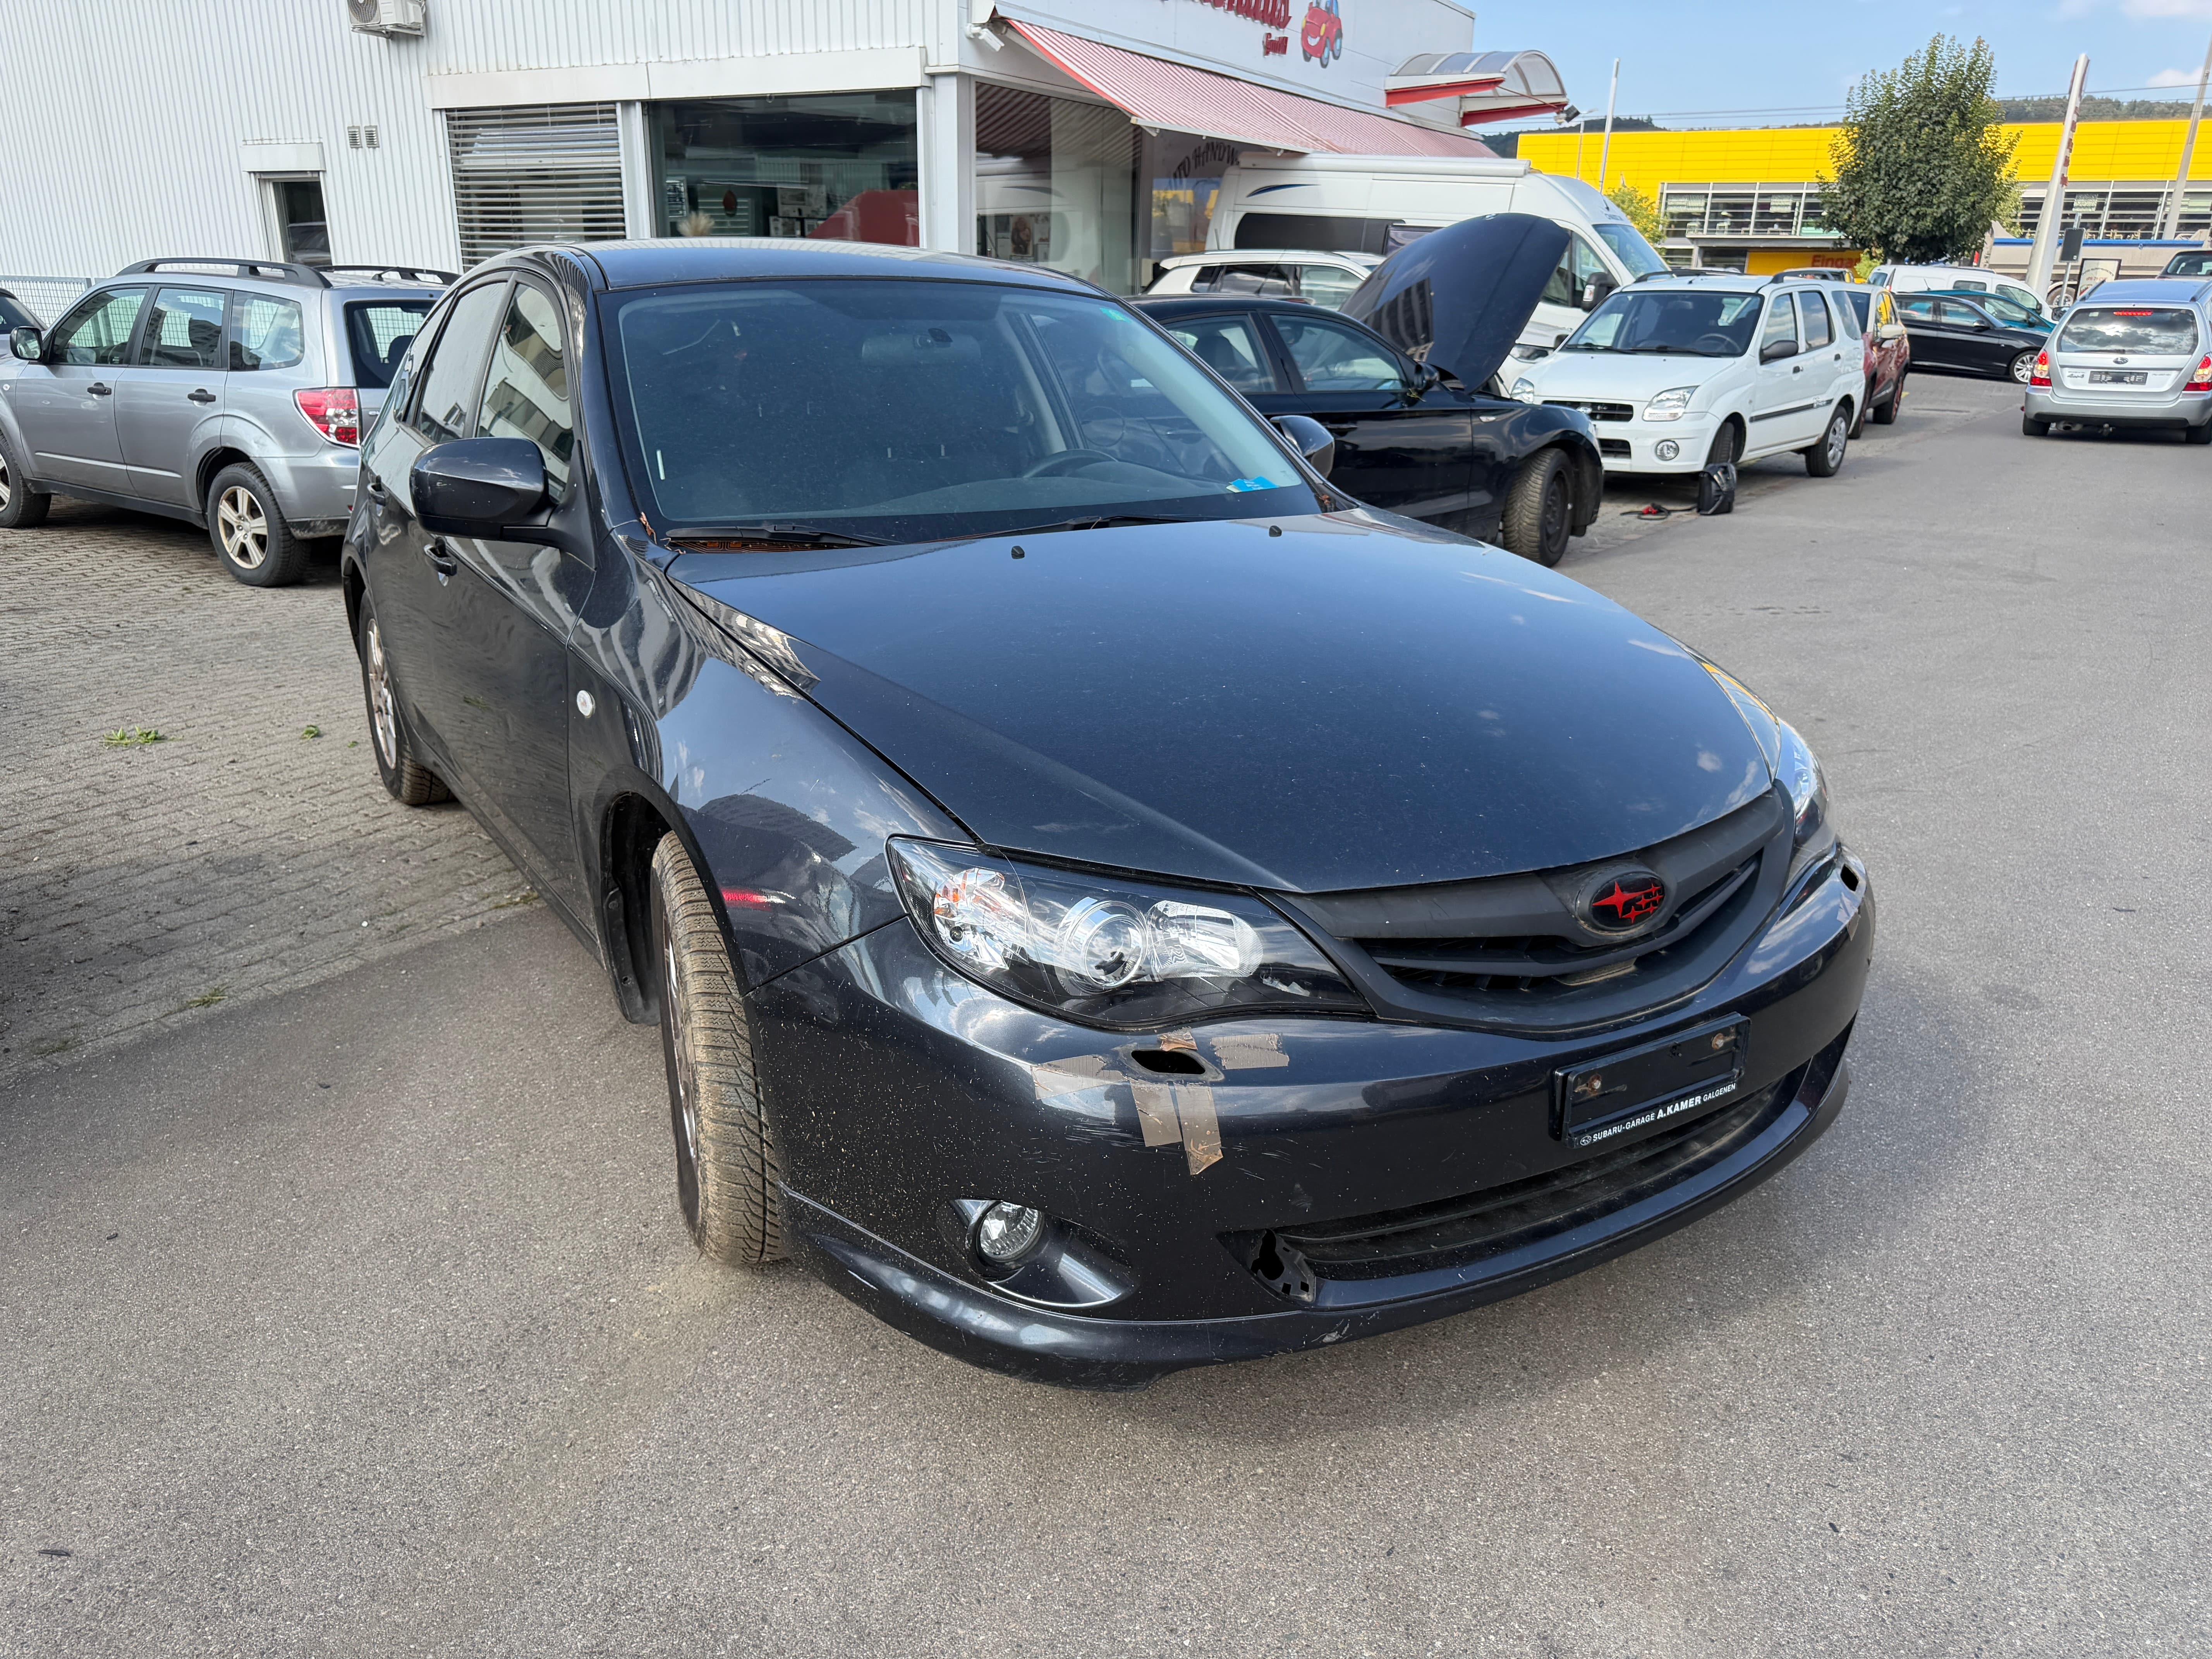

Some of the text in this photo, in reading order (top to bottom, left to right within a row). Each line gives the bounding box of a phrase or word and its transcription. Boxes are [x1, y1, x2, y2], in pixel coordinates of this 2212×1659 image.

[1592, 1083, 1736, 1142] SUBARU-GARAGE A.KAMER GALGENEN
